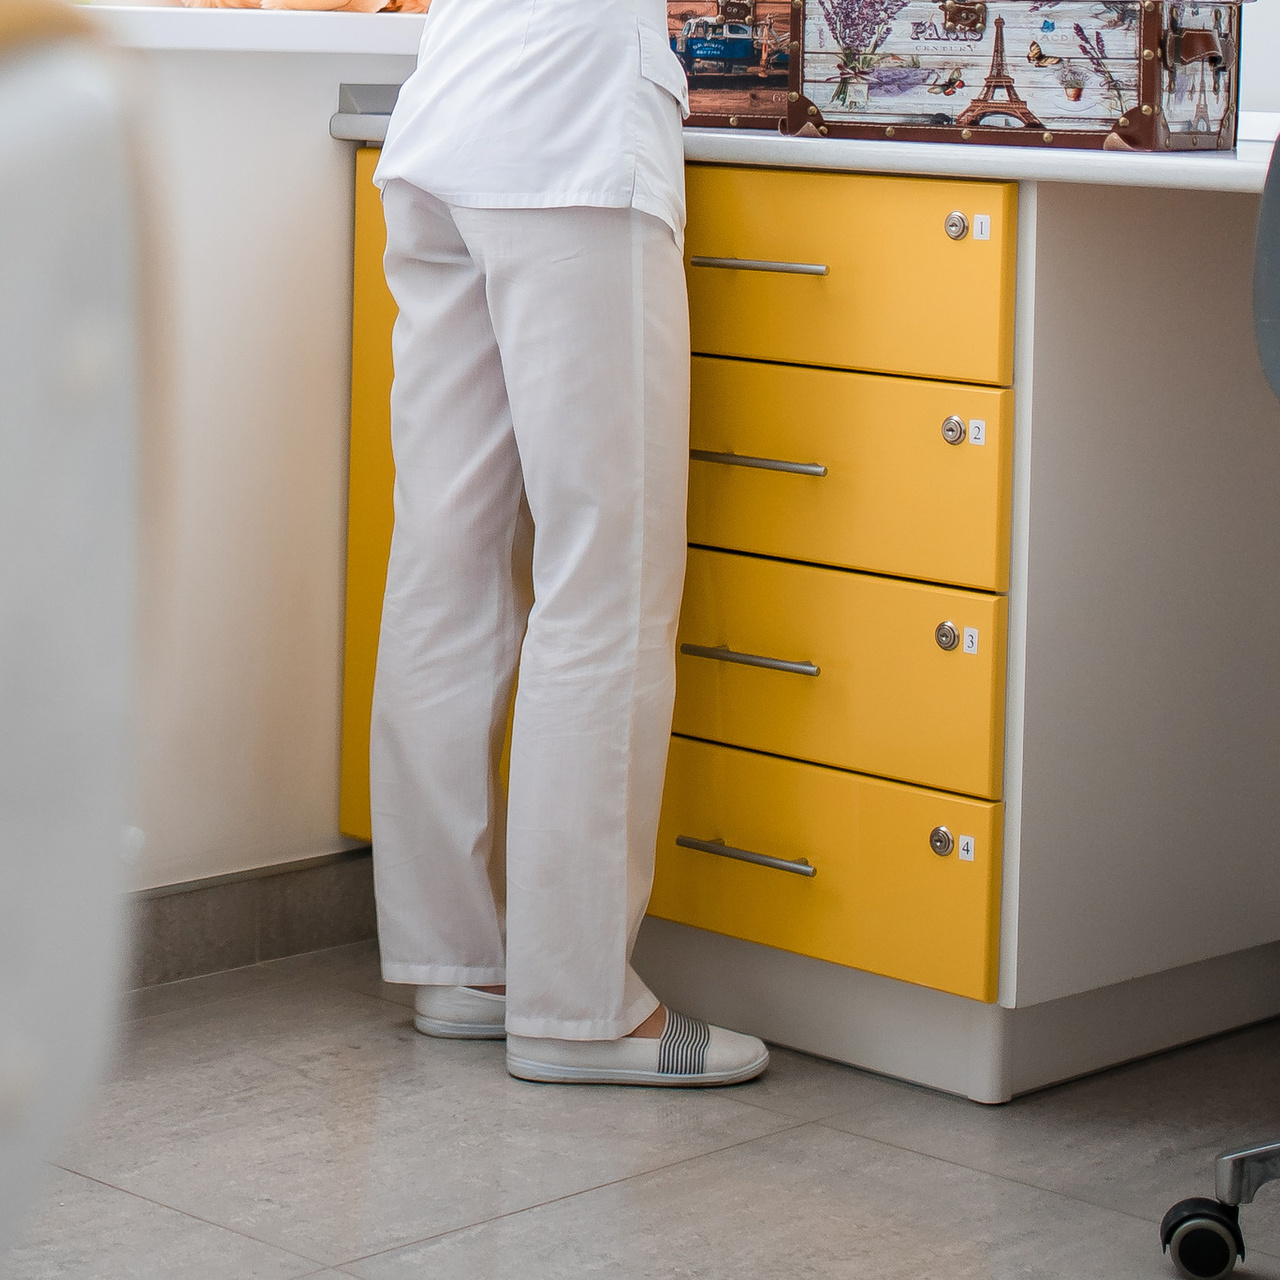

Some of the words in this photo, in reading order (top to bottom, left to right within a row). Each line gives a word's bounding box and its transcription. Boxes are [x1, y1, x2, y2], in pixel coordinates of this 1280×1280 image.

[915, 44, 975, 52] CENTURY
[973, 426, 981, 440] 2
[967, 634, 974, 648] 3
[962, 841, 970, 855] 4
